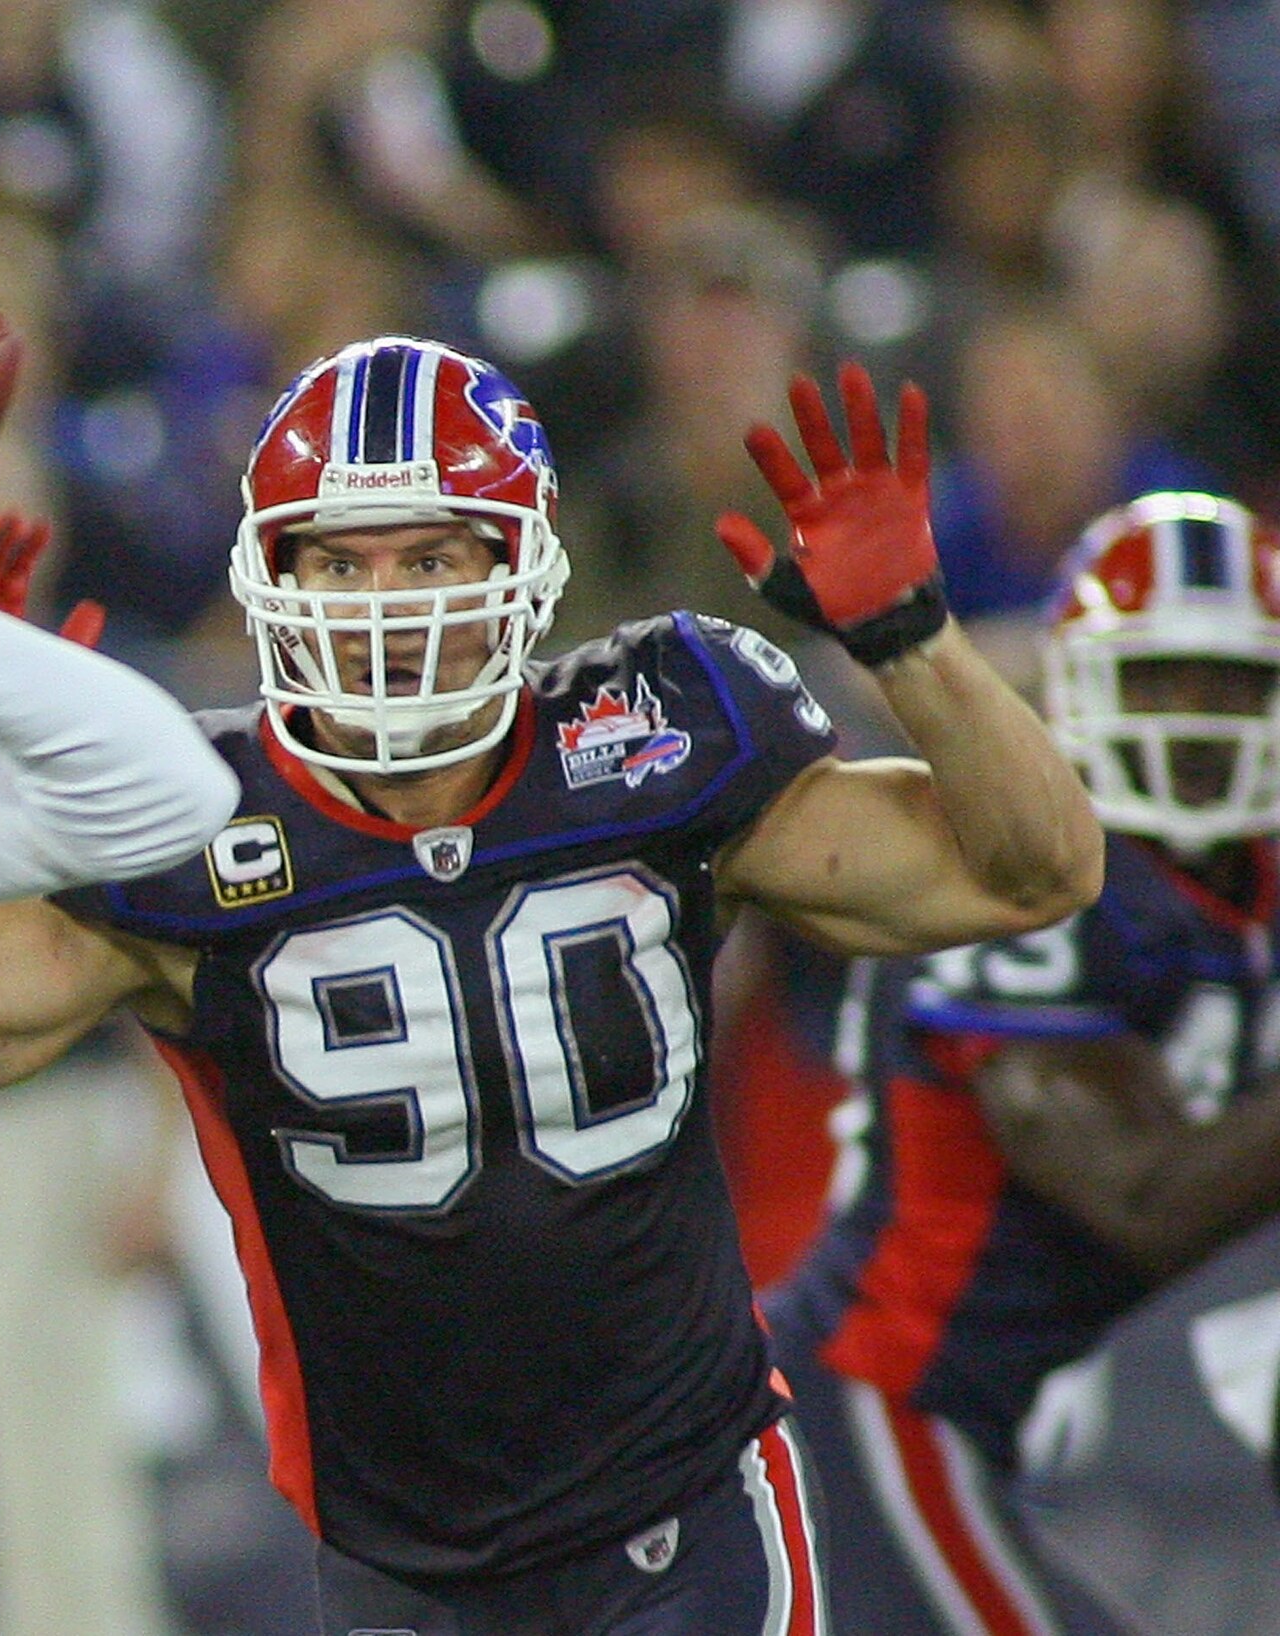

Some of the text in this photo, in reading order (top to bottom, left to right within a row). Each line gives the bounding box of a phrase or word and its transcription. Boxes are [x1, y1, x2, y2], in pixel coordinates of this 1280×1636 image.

[346, 469, 412, 488] Riddell
[213, 822, 282, 883] C
[250, 861, 703, 1217] 90
